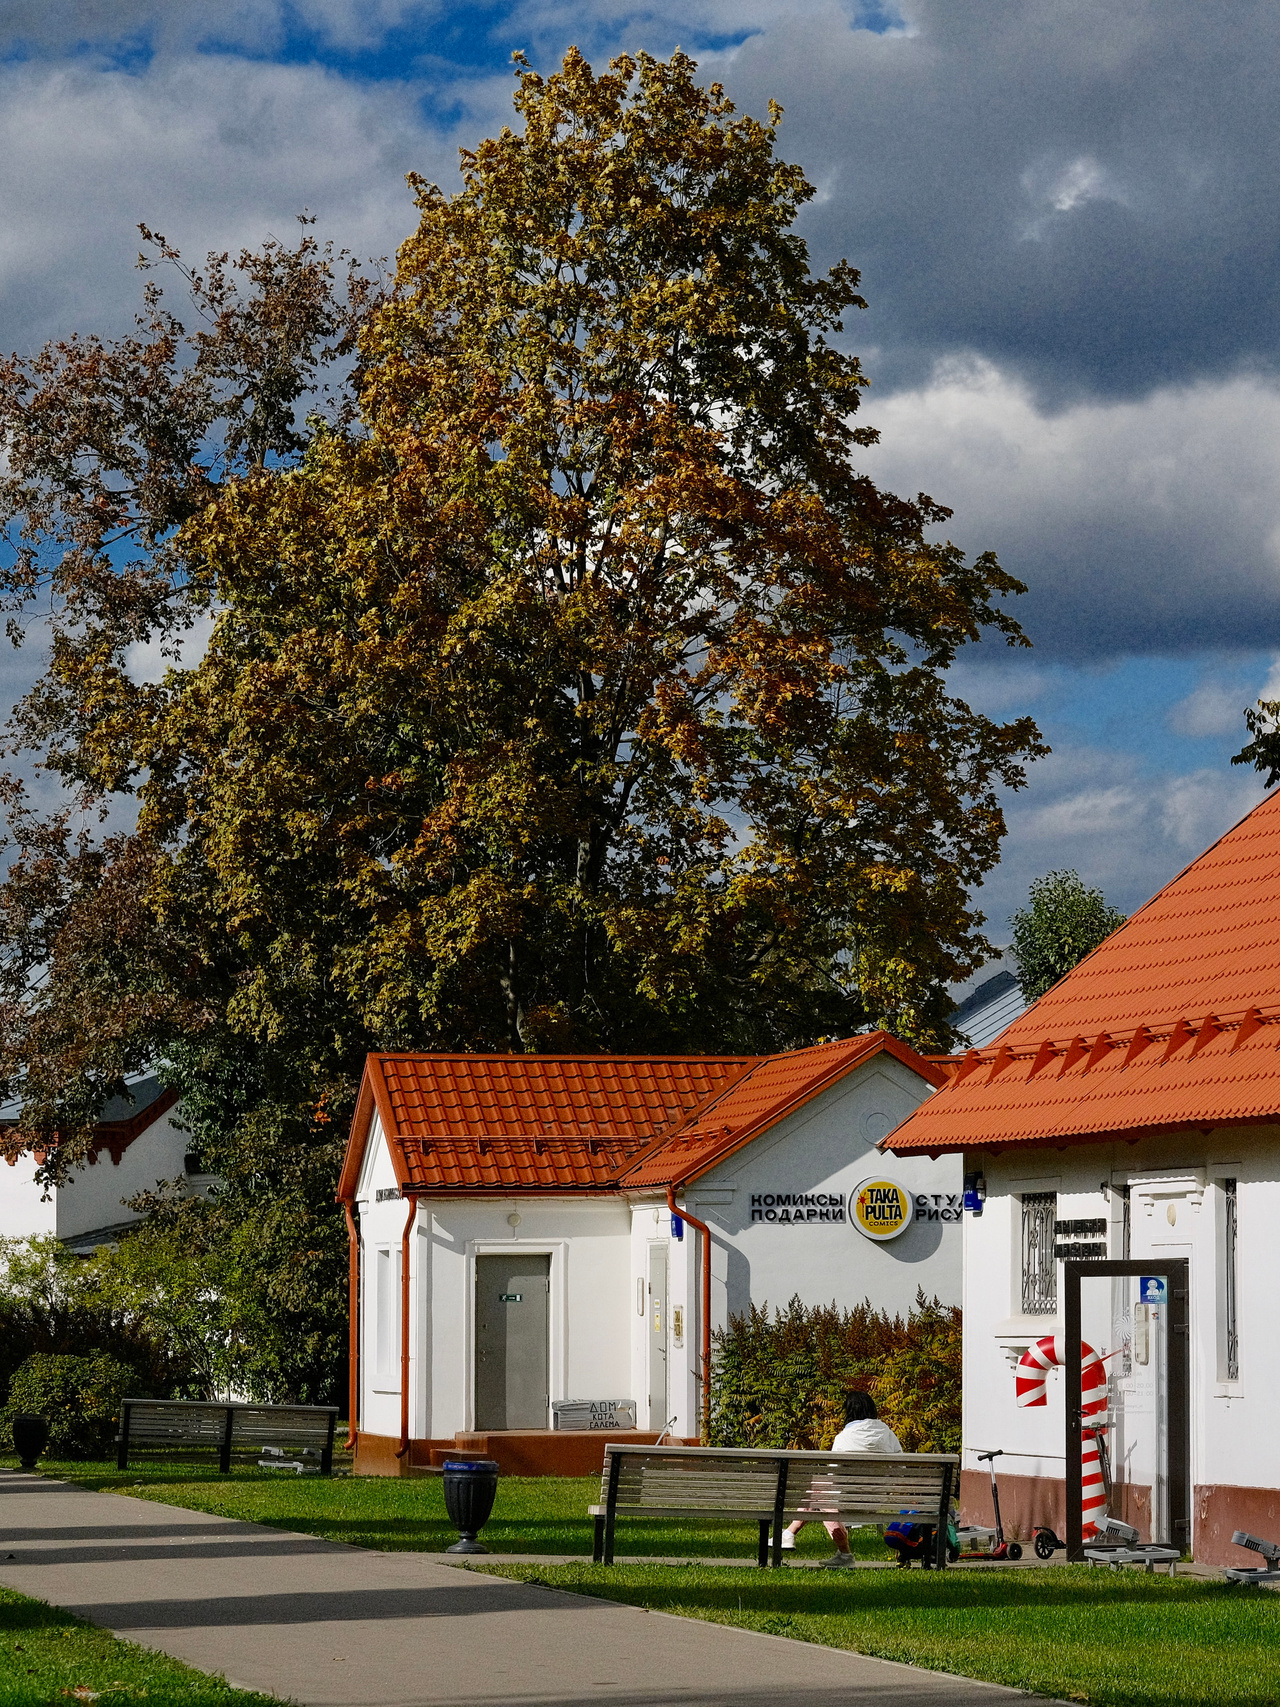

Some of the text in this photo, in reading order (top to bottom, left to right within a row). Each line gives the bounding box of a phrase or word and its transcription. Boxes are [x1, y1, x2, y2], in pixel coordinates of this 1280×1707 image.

[751, 1194, 843, 1207] КОМИКСЫ
[867, 1188, 900, 1203] TAKA
[916, 1194, 963, 1207] СТУ
[751, 1208, 844, 1223] ПОДАРКИ
[865, 1204, 903, 1221] PULTA
[589, 1402, 617, 1413] ДОМ
[592, 1413, 615, 1421] КОТА
[589, 1420, 620, 1429] САЛЕМА
